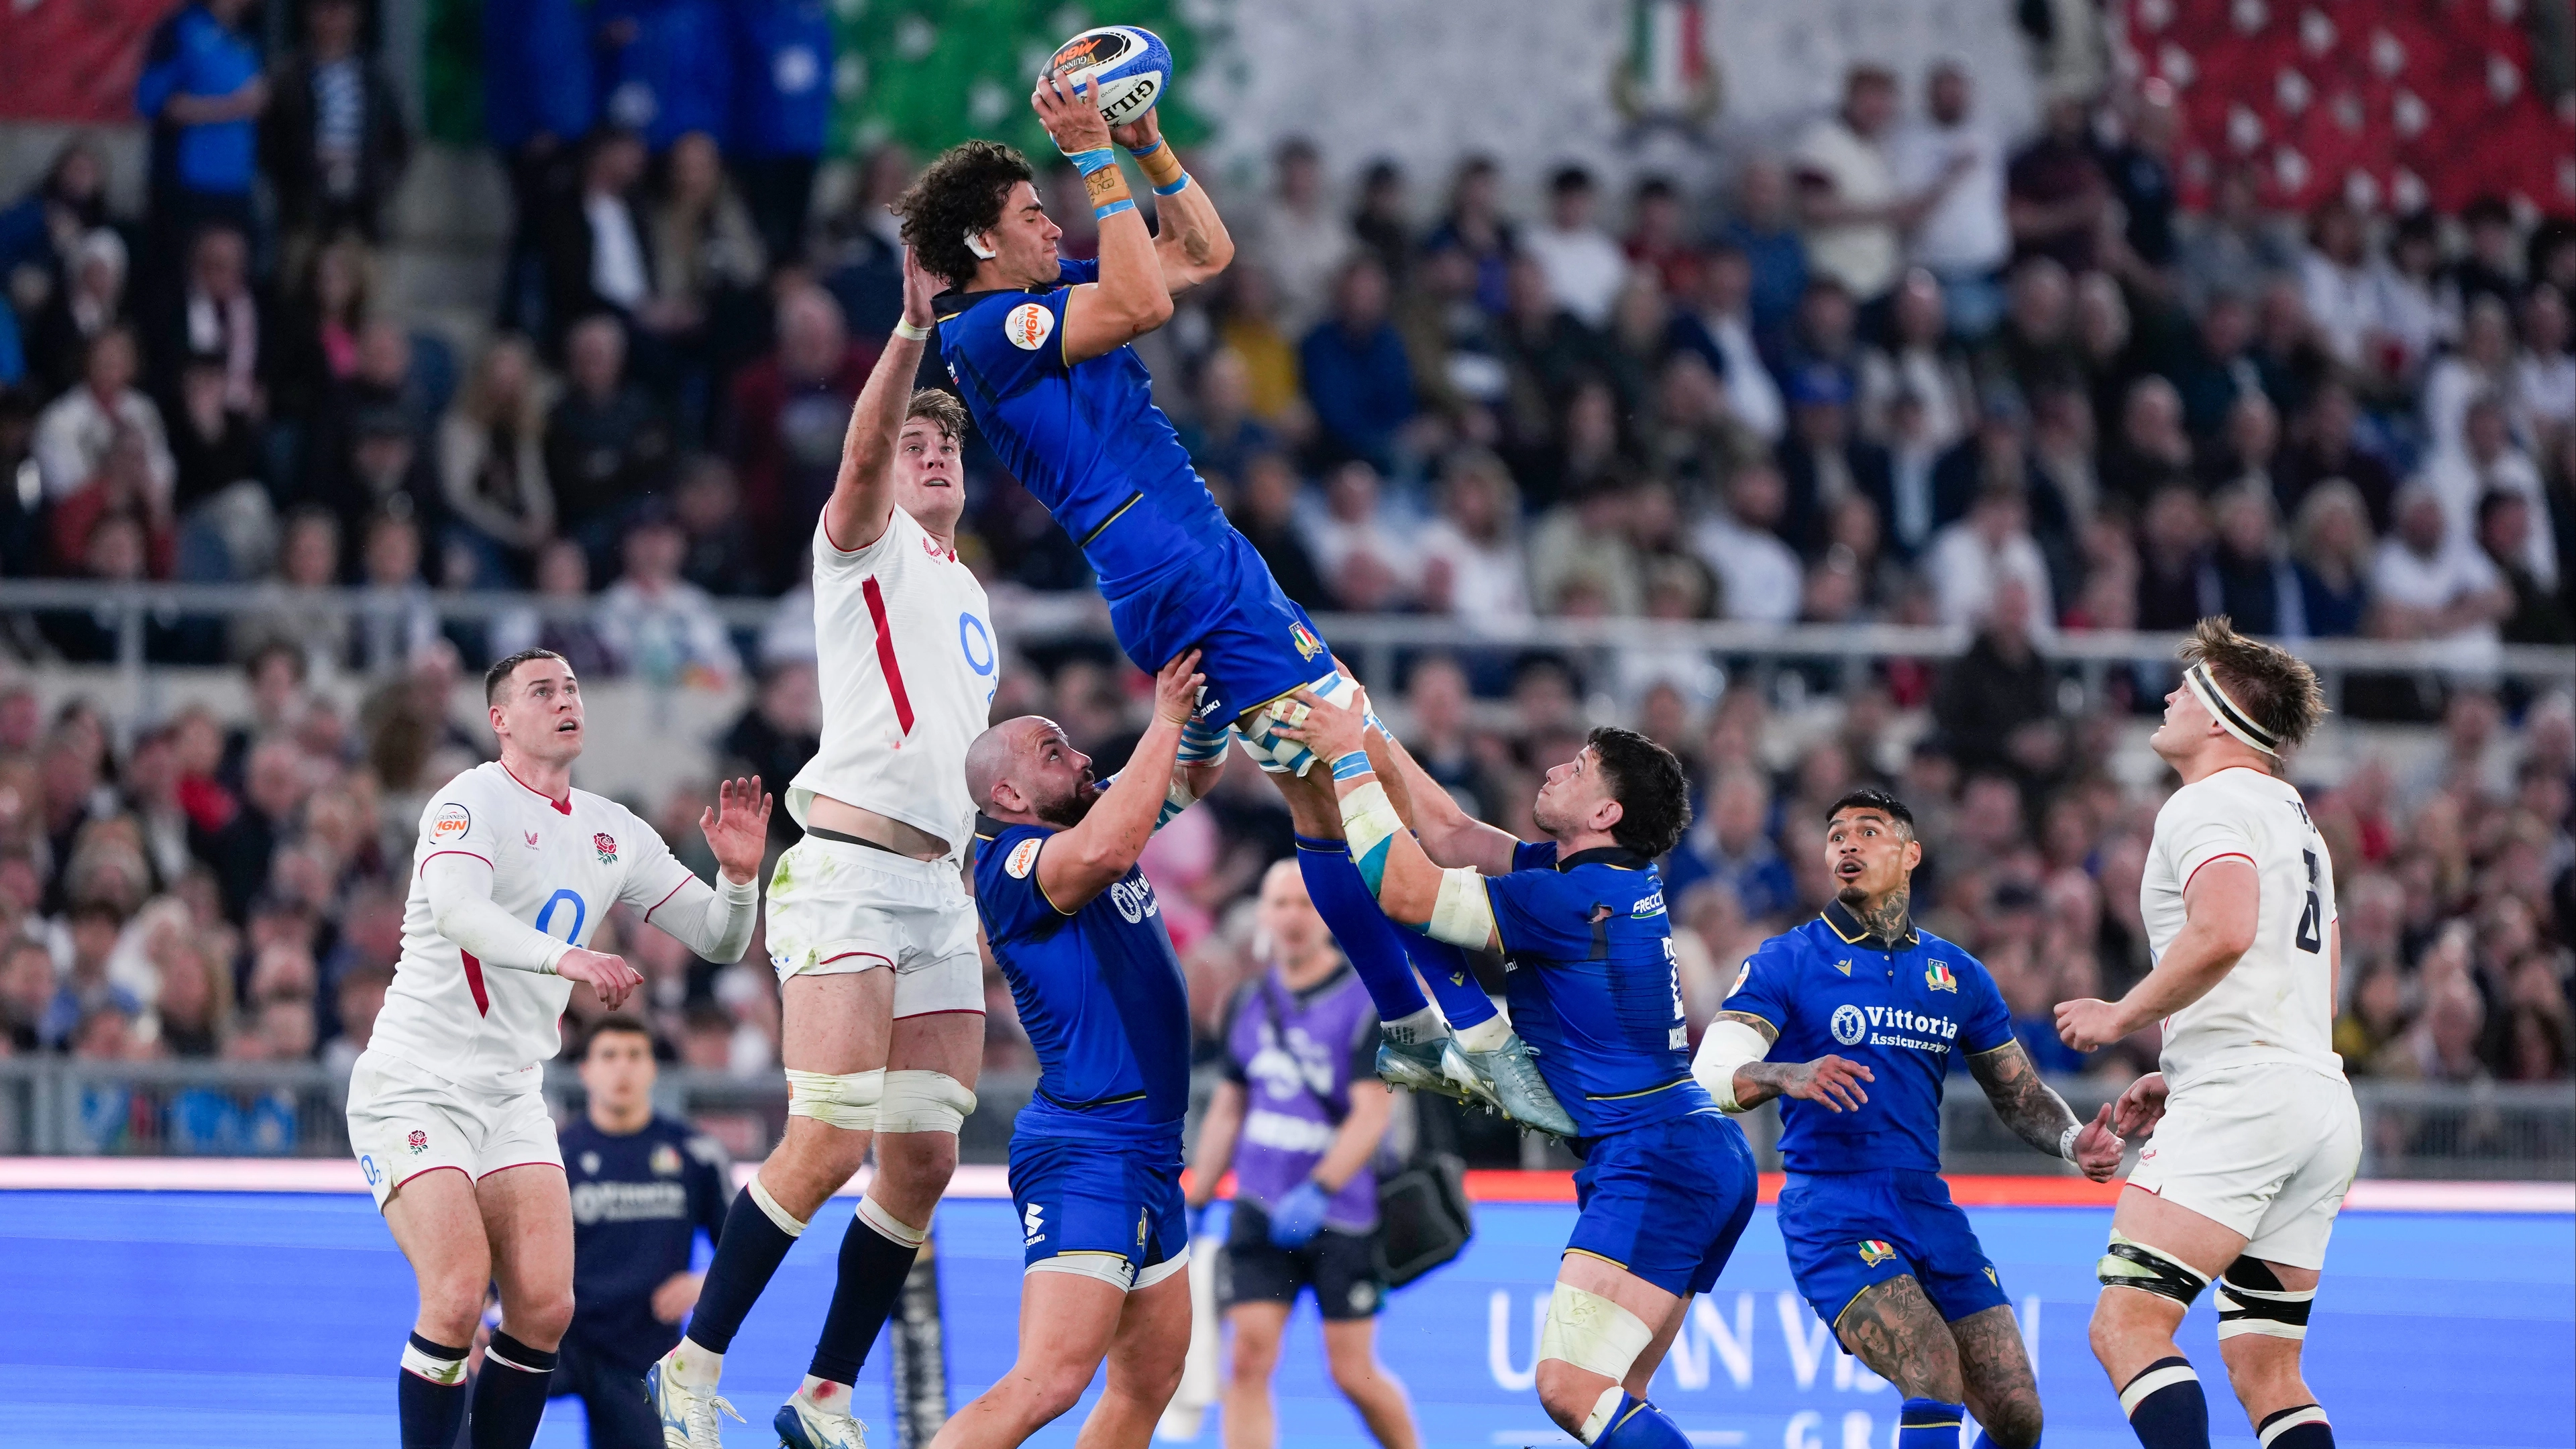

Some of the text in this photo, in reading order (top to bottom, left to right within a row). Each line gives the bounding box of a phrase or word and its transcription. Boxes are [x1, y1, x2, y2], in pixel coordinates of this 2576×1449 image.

[1059, 56, 1087, 72] GUINNE
[1099, 80, 1155, 121] GILB
[1017, 306, 1026, 337] GUINNESS
[1199, 699, 1221, 718] ZUKI
[1632, 888, 1664, 913] FRECCI
[1864, 1006, 1958, 1039] Vittoria
[1026, 1234, 1045, 1246] ZUKI
